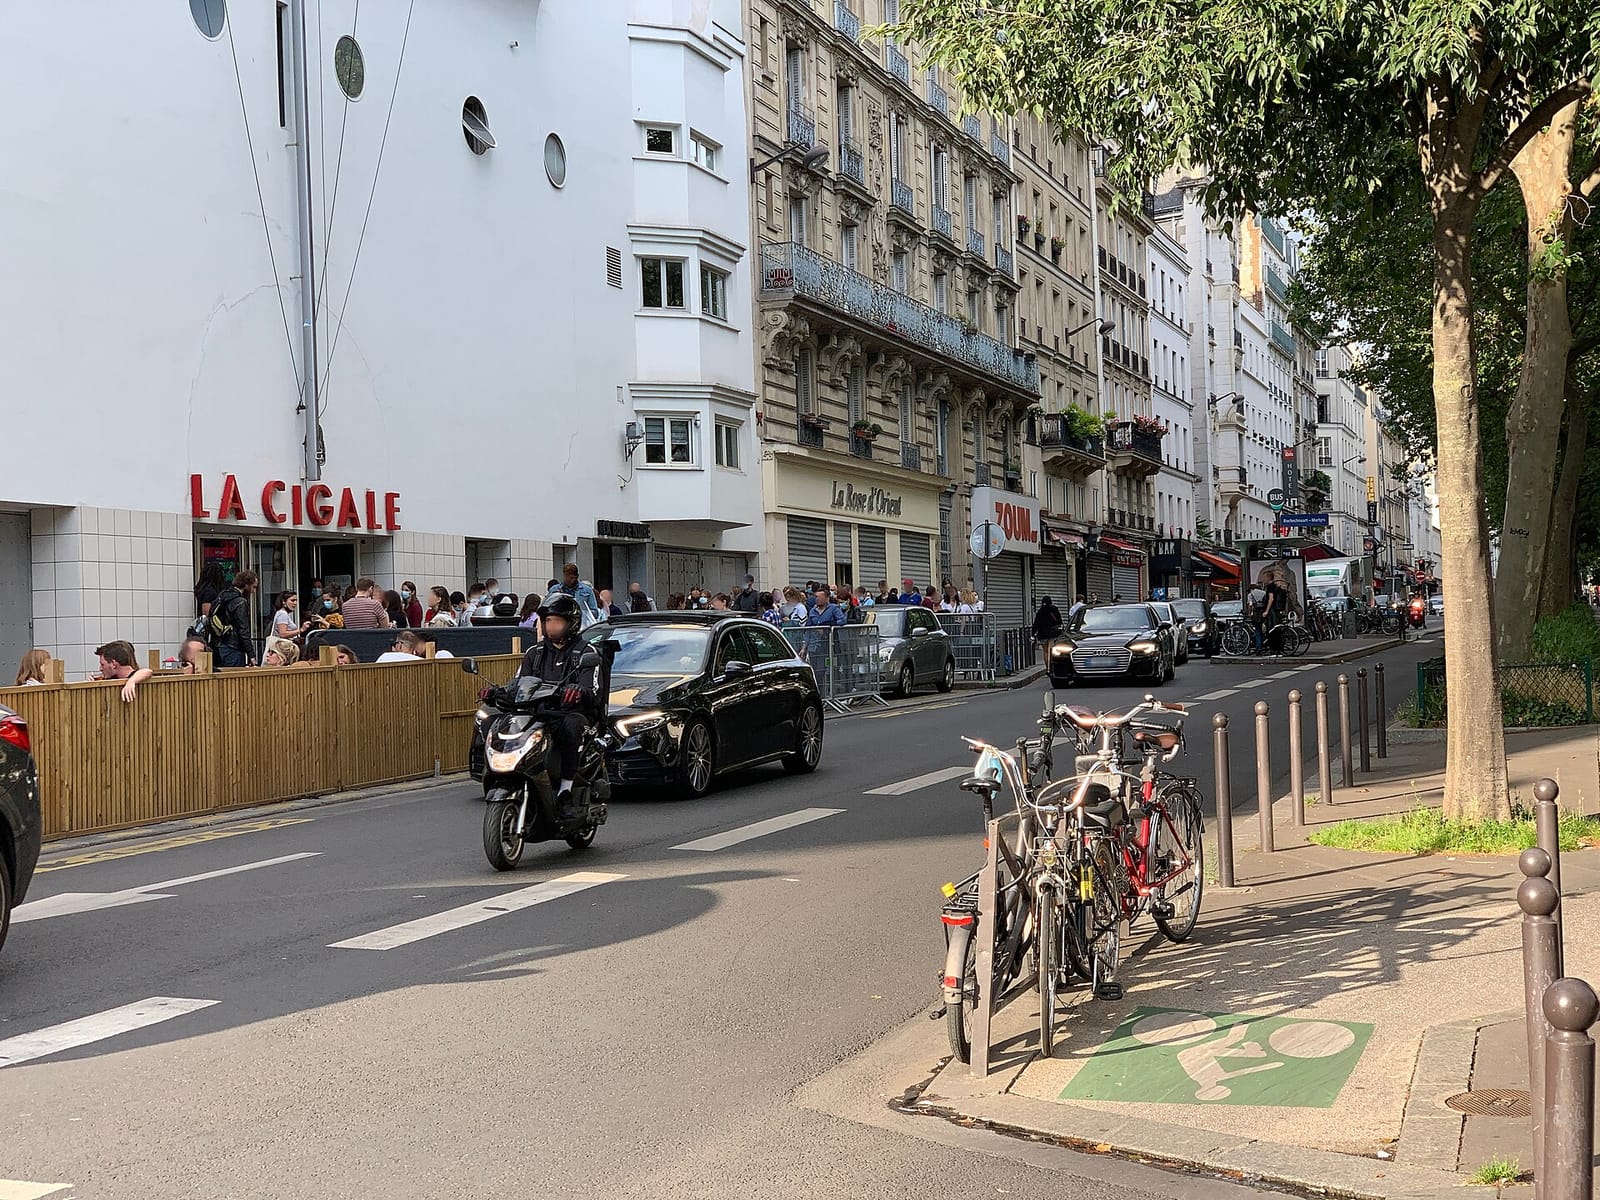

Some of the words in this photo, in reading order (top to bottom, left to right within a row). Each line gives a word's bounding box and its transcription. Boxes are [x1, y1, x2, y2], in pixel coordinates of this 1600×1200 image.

[190, 473, 247, 521] LA
[262, 480, 401, 531] CIGALE
[831, 480, 845, 508] La
[845, 483, 867, 512] Rose
[867, 486, 902, 518] d'Orient
[1270, 493, 1284, 501] BUS
[1158, 541, 1175, 555] BAR
